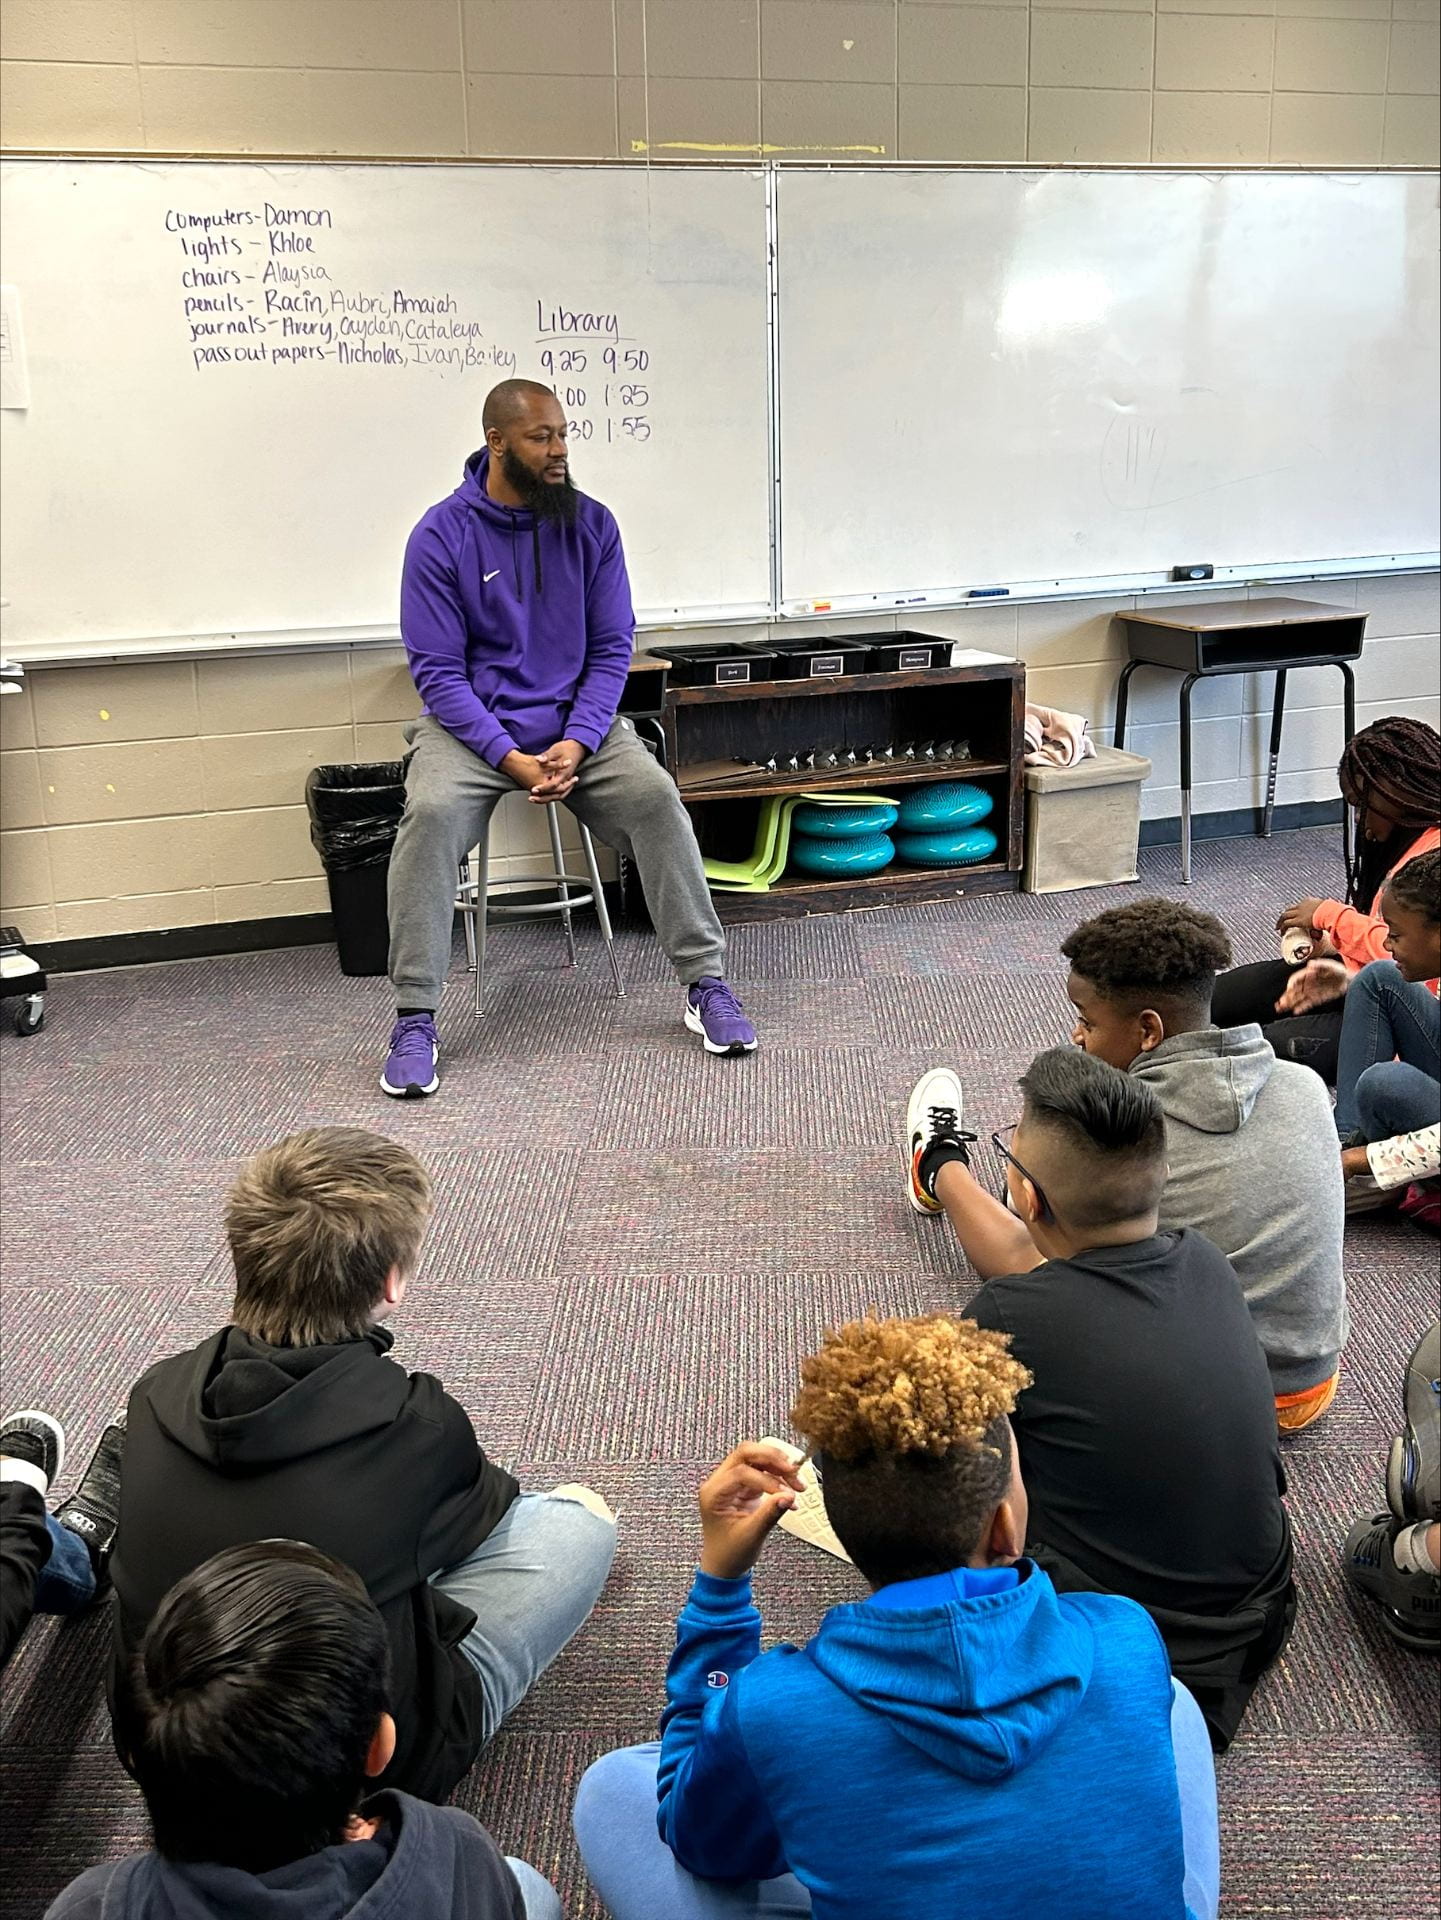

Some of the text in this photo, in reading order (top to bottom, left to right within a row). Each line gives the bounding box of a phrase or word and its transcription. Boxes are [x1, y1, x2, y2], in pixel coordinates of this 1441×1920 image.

[269, 230, 316, 256] Khloe
[262, 260, 332, 288] Alaysia
[538, 299, 619, 344] Library
[568, 419, 593, 440] 30
